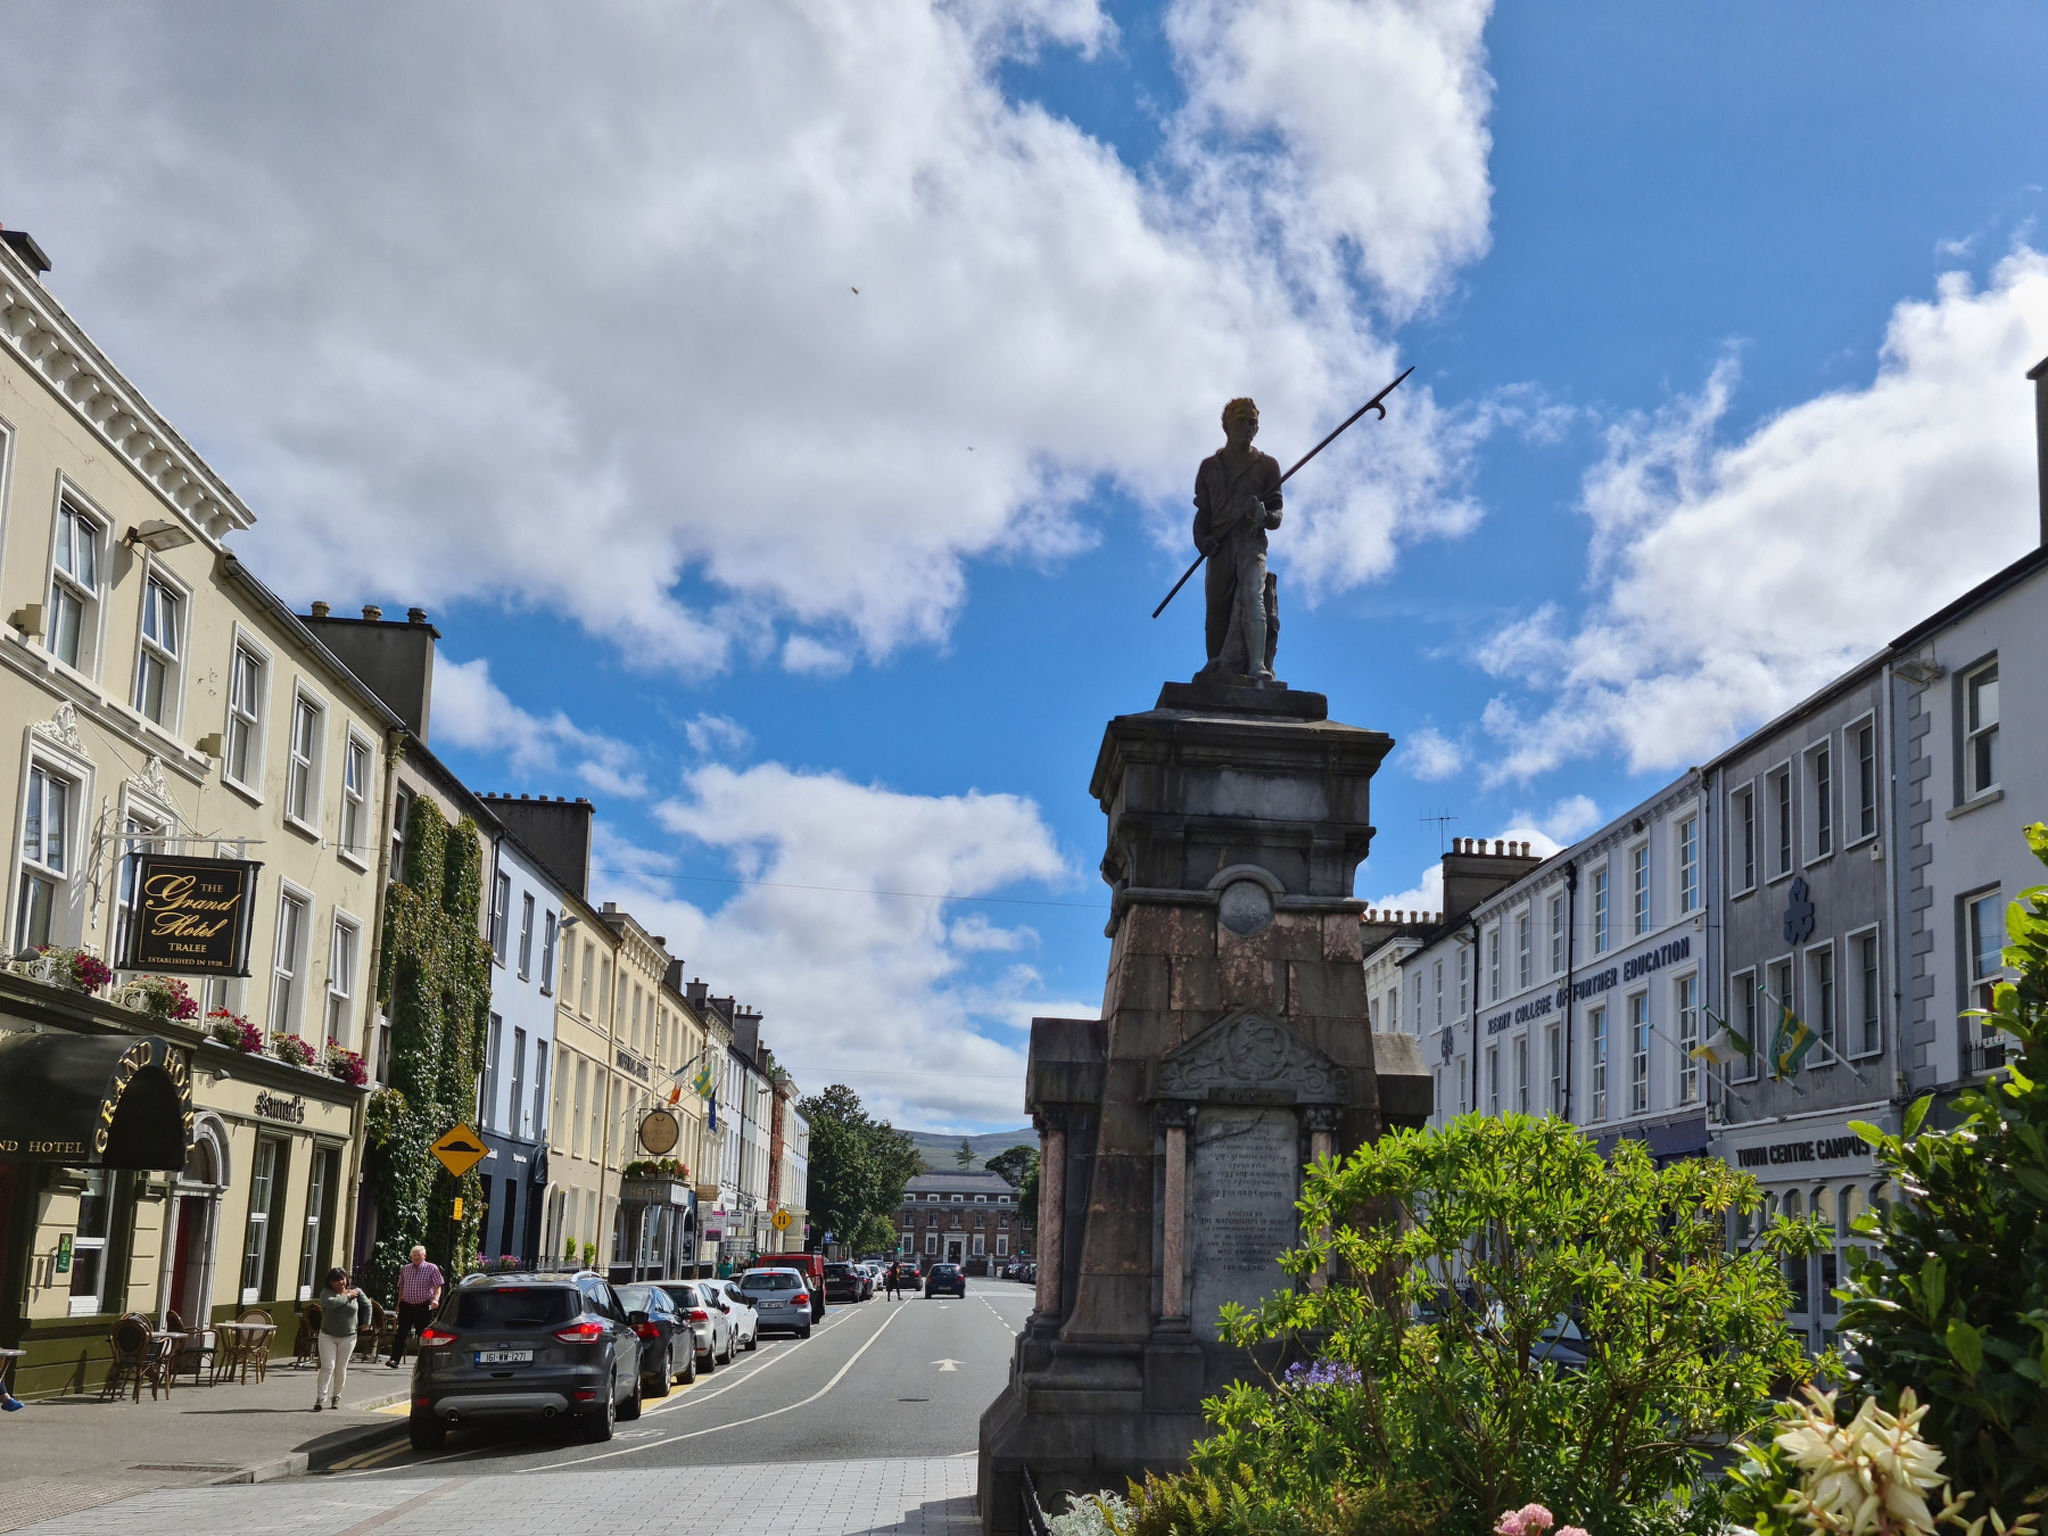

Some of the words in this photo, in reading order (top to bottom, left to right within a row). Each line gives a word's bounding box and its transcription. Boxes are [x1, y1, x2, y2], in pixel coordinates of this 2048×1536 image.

[144, 874, 242, 911] Grand
[200, 883, 223, 893] THE
[151, 911, 228, 938] Hotel
[168, 942, 207, 953] TRALEE
[147, 956, 195, 966] ESTABLISHED
[196, 958, 206, 966] IN
[1487, 1010, 1512, 1036] KERRY
[1514, 994, 1552, 1025] COLLEGE
[1556, 987, 1568, 1009] OF
[1572, 966, 1618, 1003] FURTHER
[1623, 936, 1690, 982] EDUCATION
[28, 1141, 85, 1154] HOTEL
[1736, 1146, 1768, 1167] TOWN
[1769, 1140, 1815, 1164] CENTRE
[1816, 1134, 1871, 1160] CAMPUS
[631, 1187, 662, 1197] HOTEL
